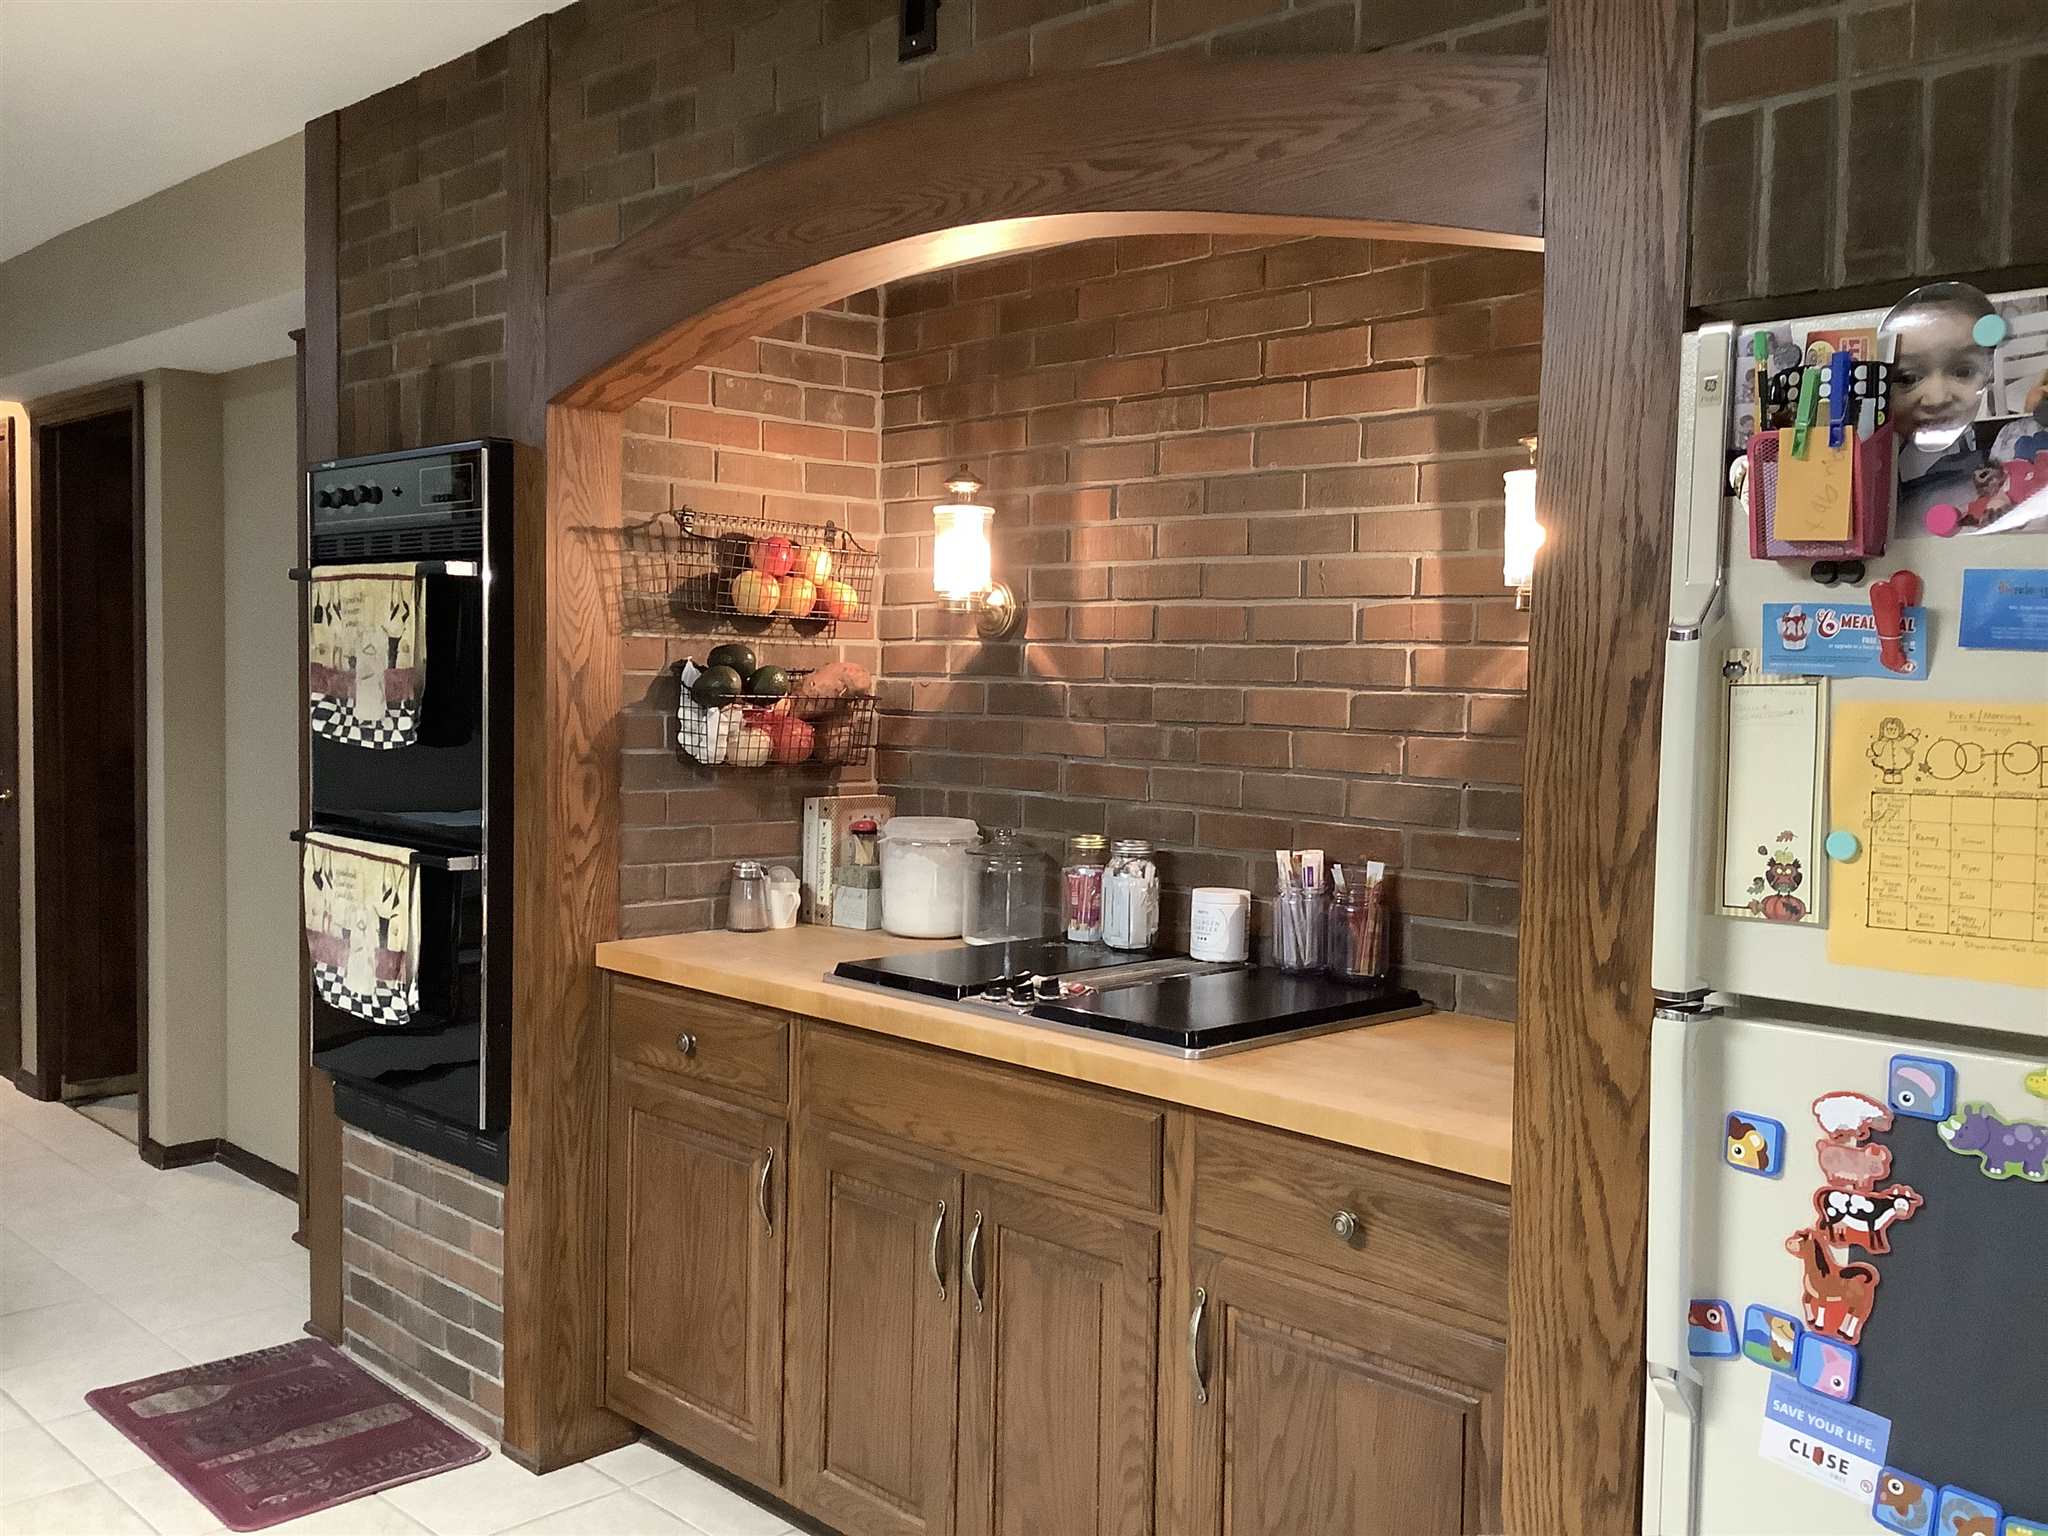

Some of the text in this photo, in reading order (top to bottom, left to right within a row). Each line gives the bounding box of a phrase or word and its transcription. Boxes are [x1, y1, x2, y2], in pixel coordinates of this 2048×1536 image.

[1841, 614, 1875, 630] MEAL
[1773, 1400, 1805, 1421] SAVE
[1808, 1414, 1844, 1438] YOUR
[1847, 1430, 1876, 1452] LIFE.
